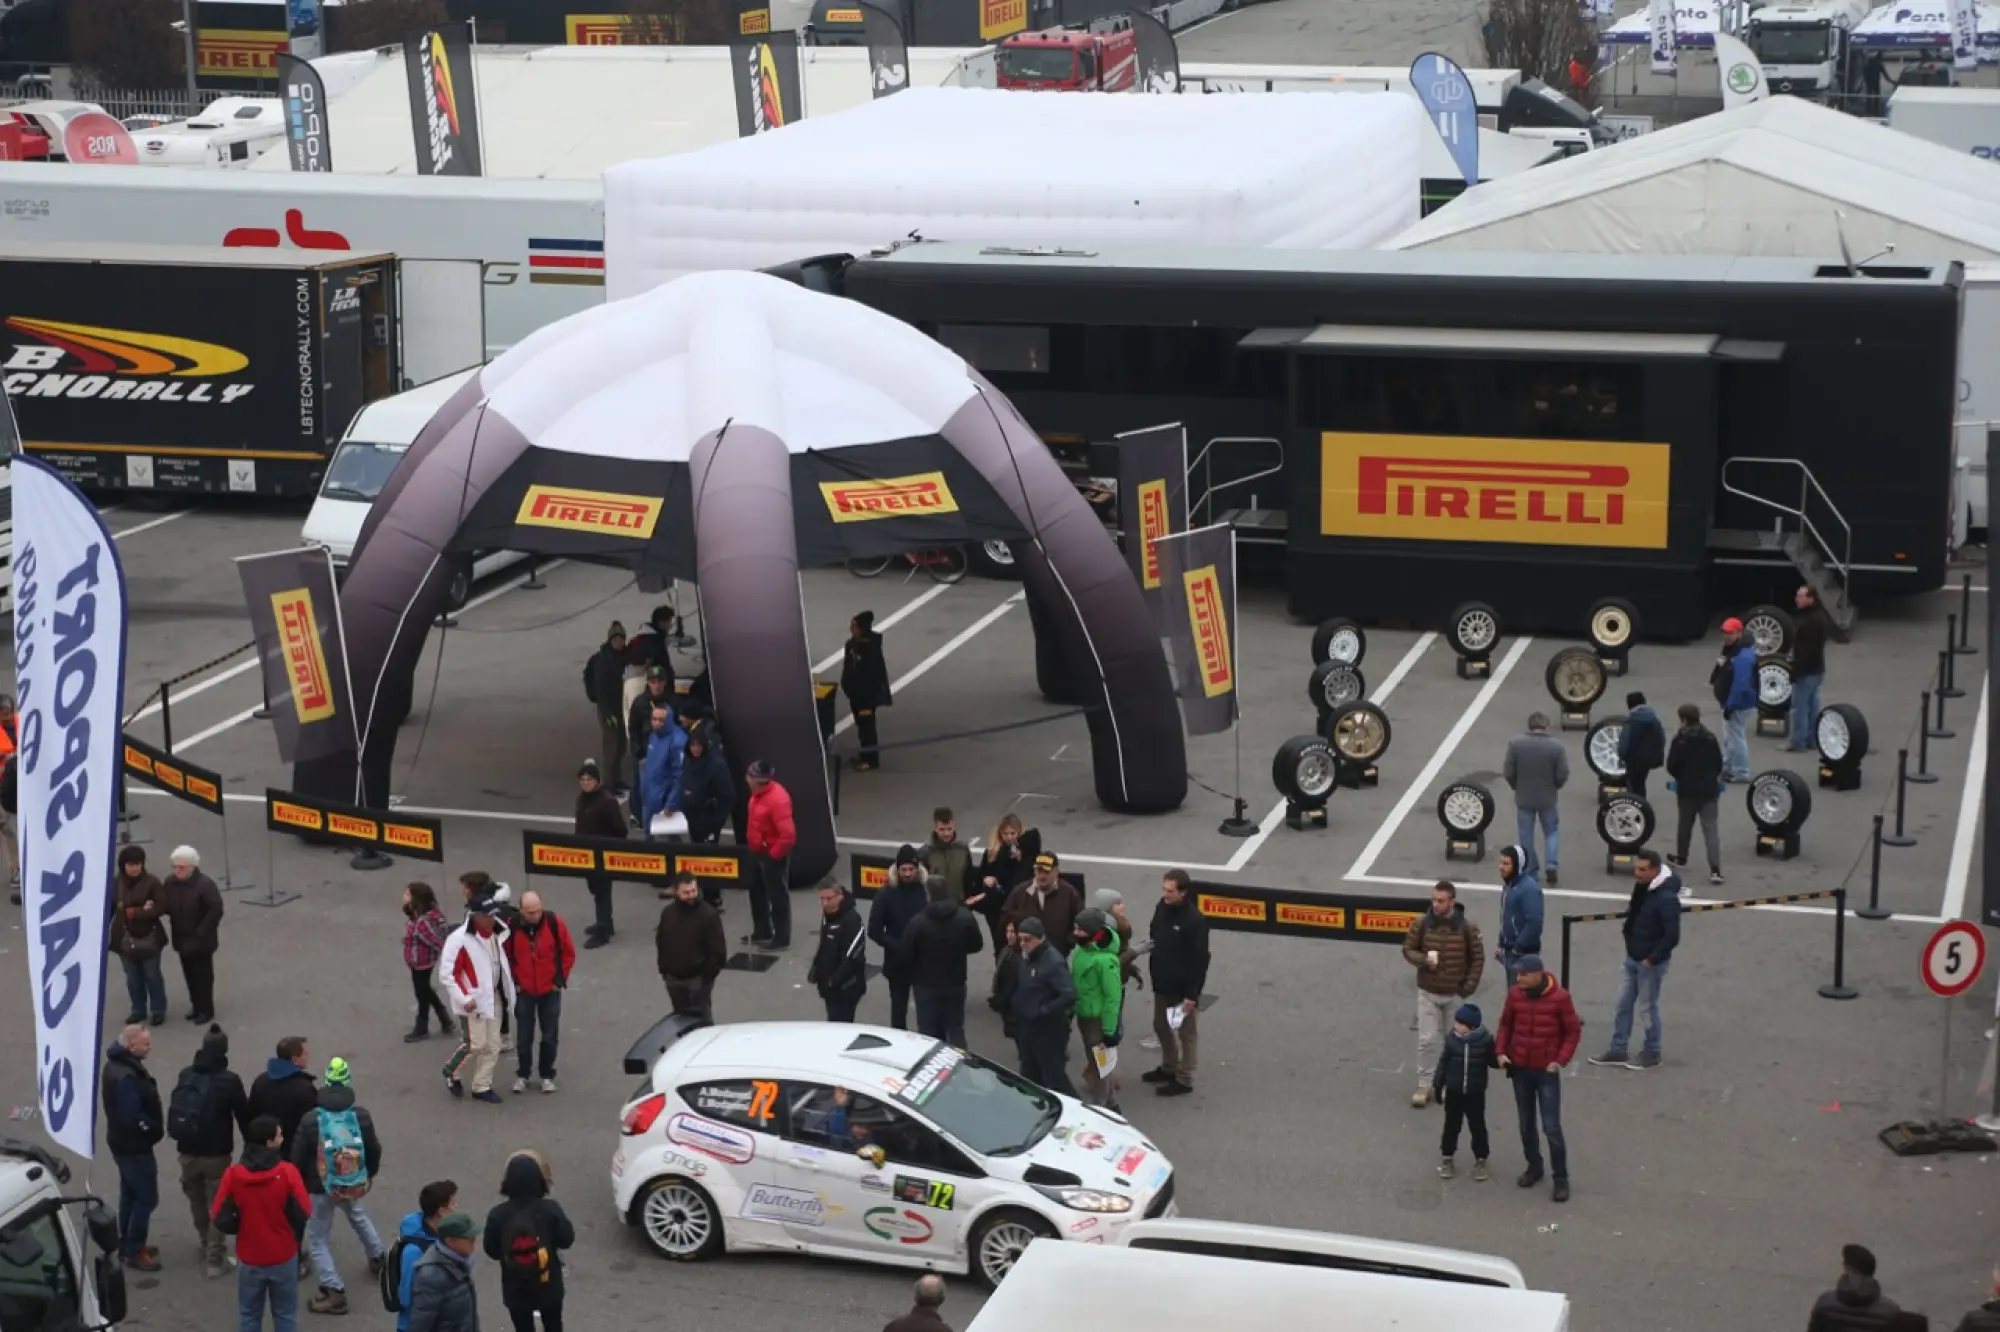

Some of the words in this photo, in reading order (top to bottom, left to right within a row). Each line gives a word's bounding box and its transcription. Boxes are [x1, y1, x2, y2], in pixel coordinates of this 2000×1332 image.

[1895, 9, 1945, 23] Pant
[297, 278, 314, 435] LBTECNORALLY.COM
[832, 482, 942, 513] PIRELLI
[1358, 456, 1630, 525] PIRELLI
[531, 494, 649, 529] PIRELLI
[277, 806, 317, 826] PIRELLI
[332, 817, 374, 836] PIRELLI
[388, 826, 429, 846] PIRELLI
[538, 848, 589, 865] PIRELLI
[609, 855, 660, 870] PIRELLI
[681, 859, 733, 873] PIRELLI
[1204, 899, 1260, 915] PIRELLI
[1282, 906, 1339, 924] PIRELLI
[1944, 941, 1962, 974] 5
[748, 1080, 778, 1118] 72
[929, 1181, 954, 1210] 72
